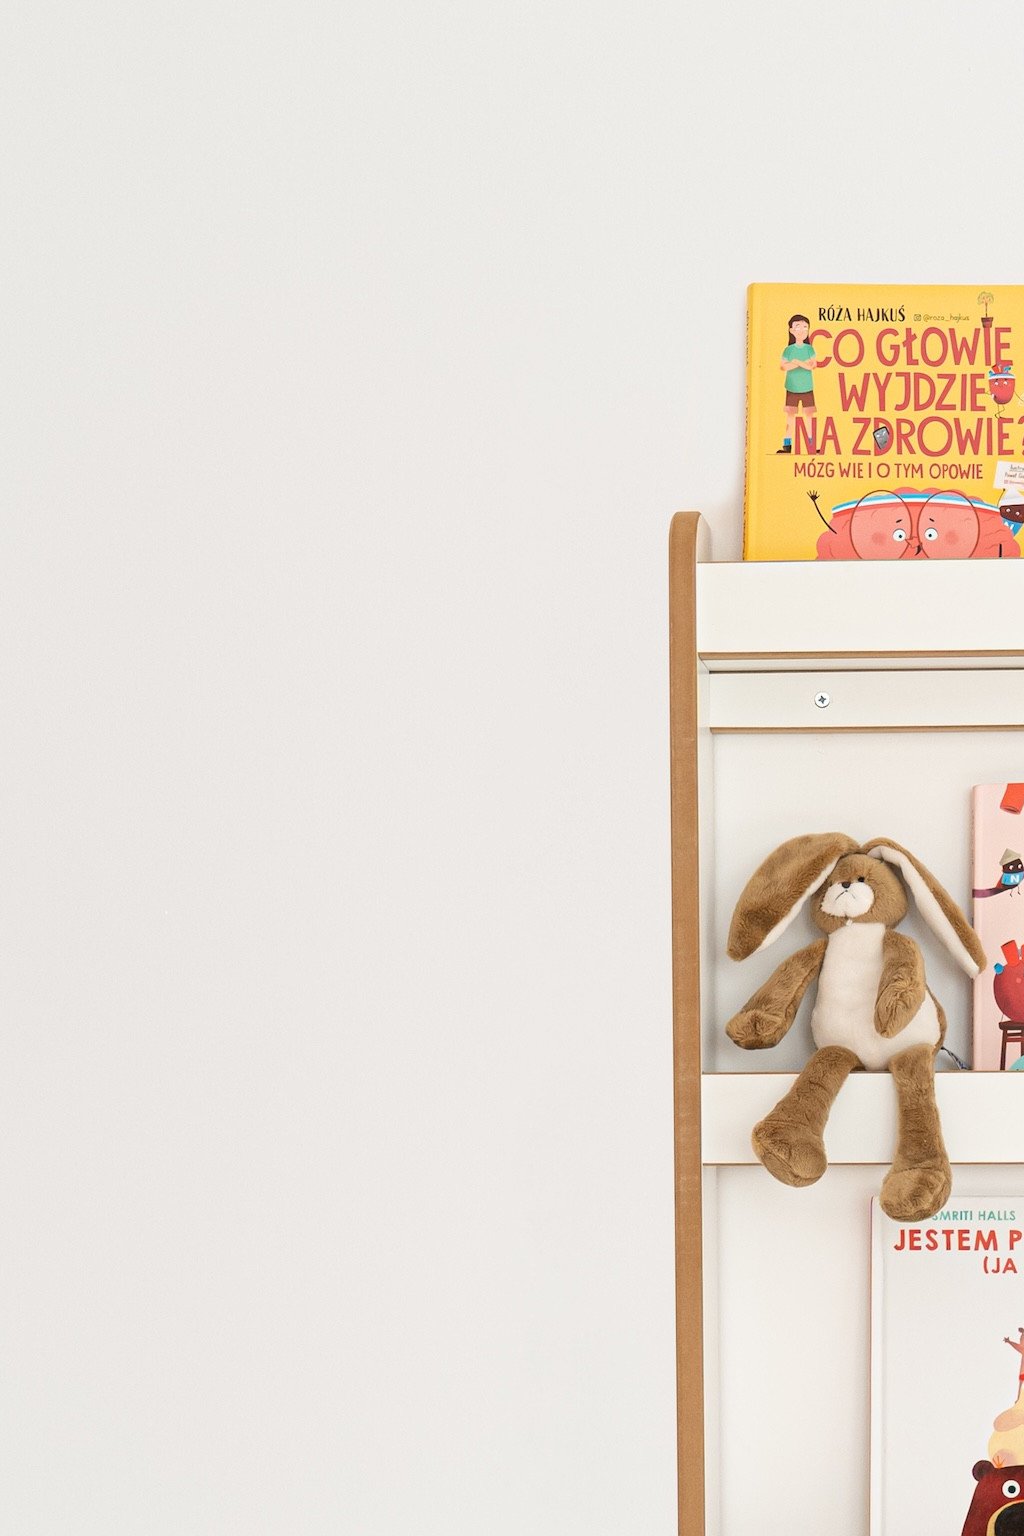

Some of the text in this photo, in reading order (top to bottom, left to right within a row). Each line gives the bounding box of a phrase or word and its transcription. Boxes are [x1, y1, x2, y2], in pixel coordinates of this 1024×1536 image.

[818, 305, 906, 322] RÓŻA HAJKUŚ
[810, 327, 1013, 368] CO GŁOWIE
[838, 372, 986, 412] WYJDZIE
[794, 416, 842, 456] NA
[794, 458, 983, 480] MÓZG WIE I O TYM OPOWIE
[978, 1210, 1016, 1221] HALLS
[893, 1229, 999, 1251] JESTEM
[983, 1256, 1018, 1274] (JA
